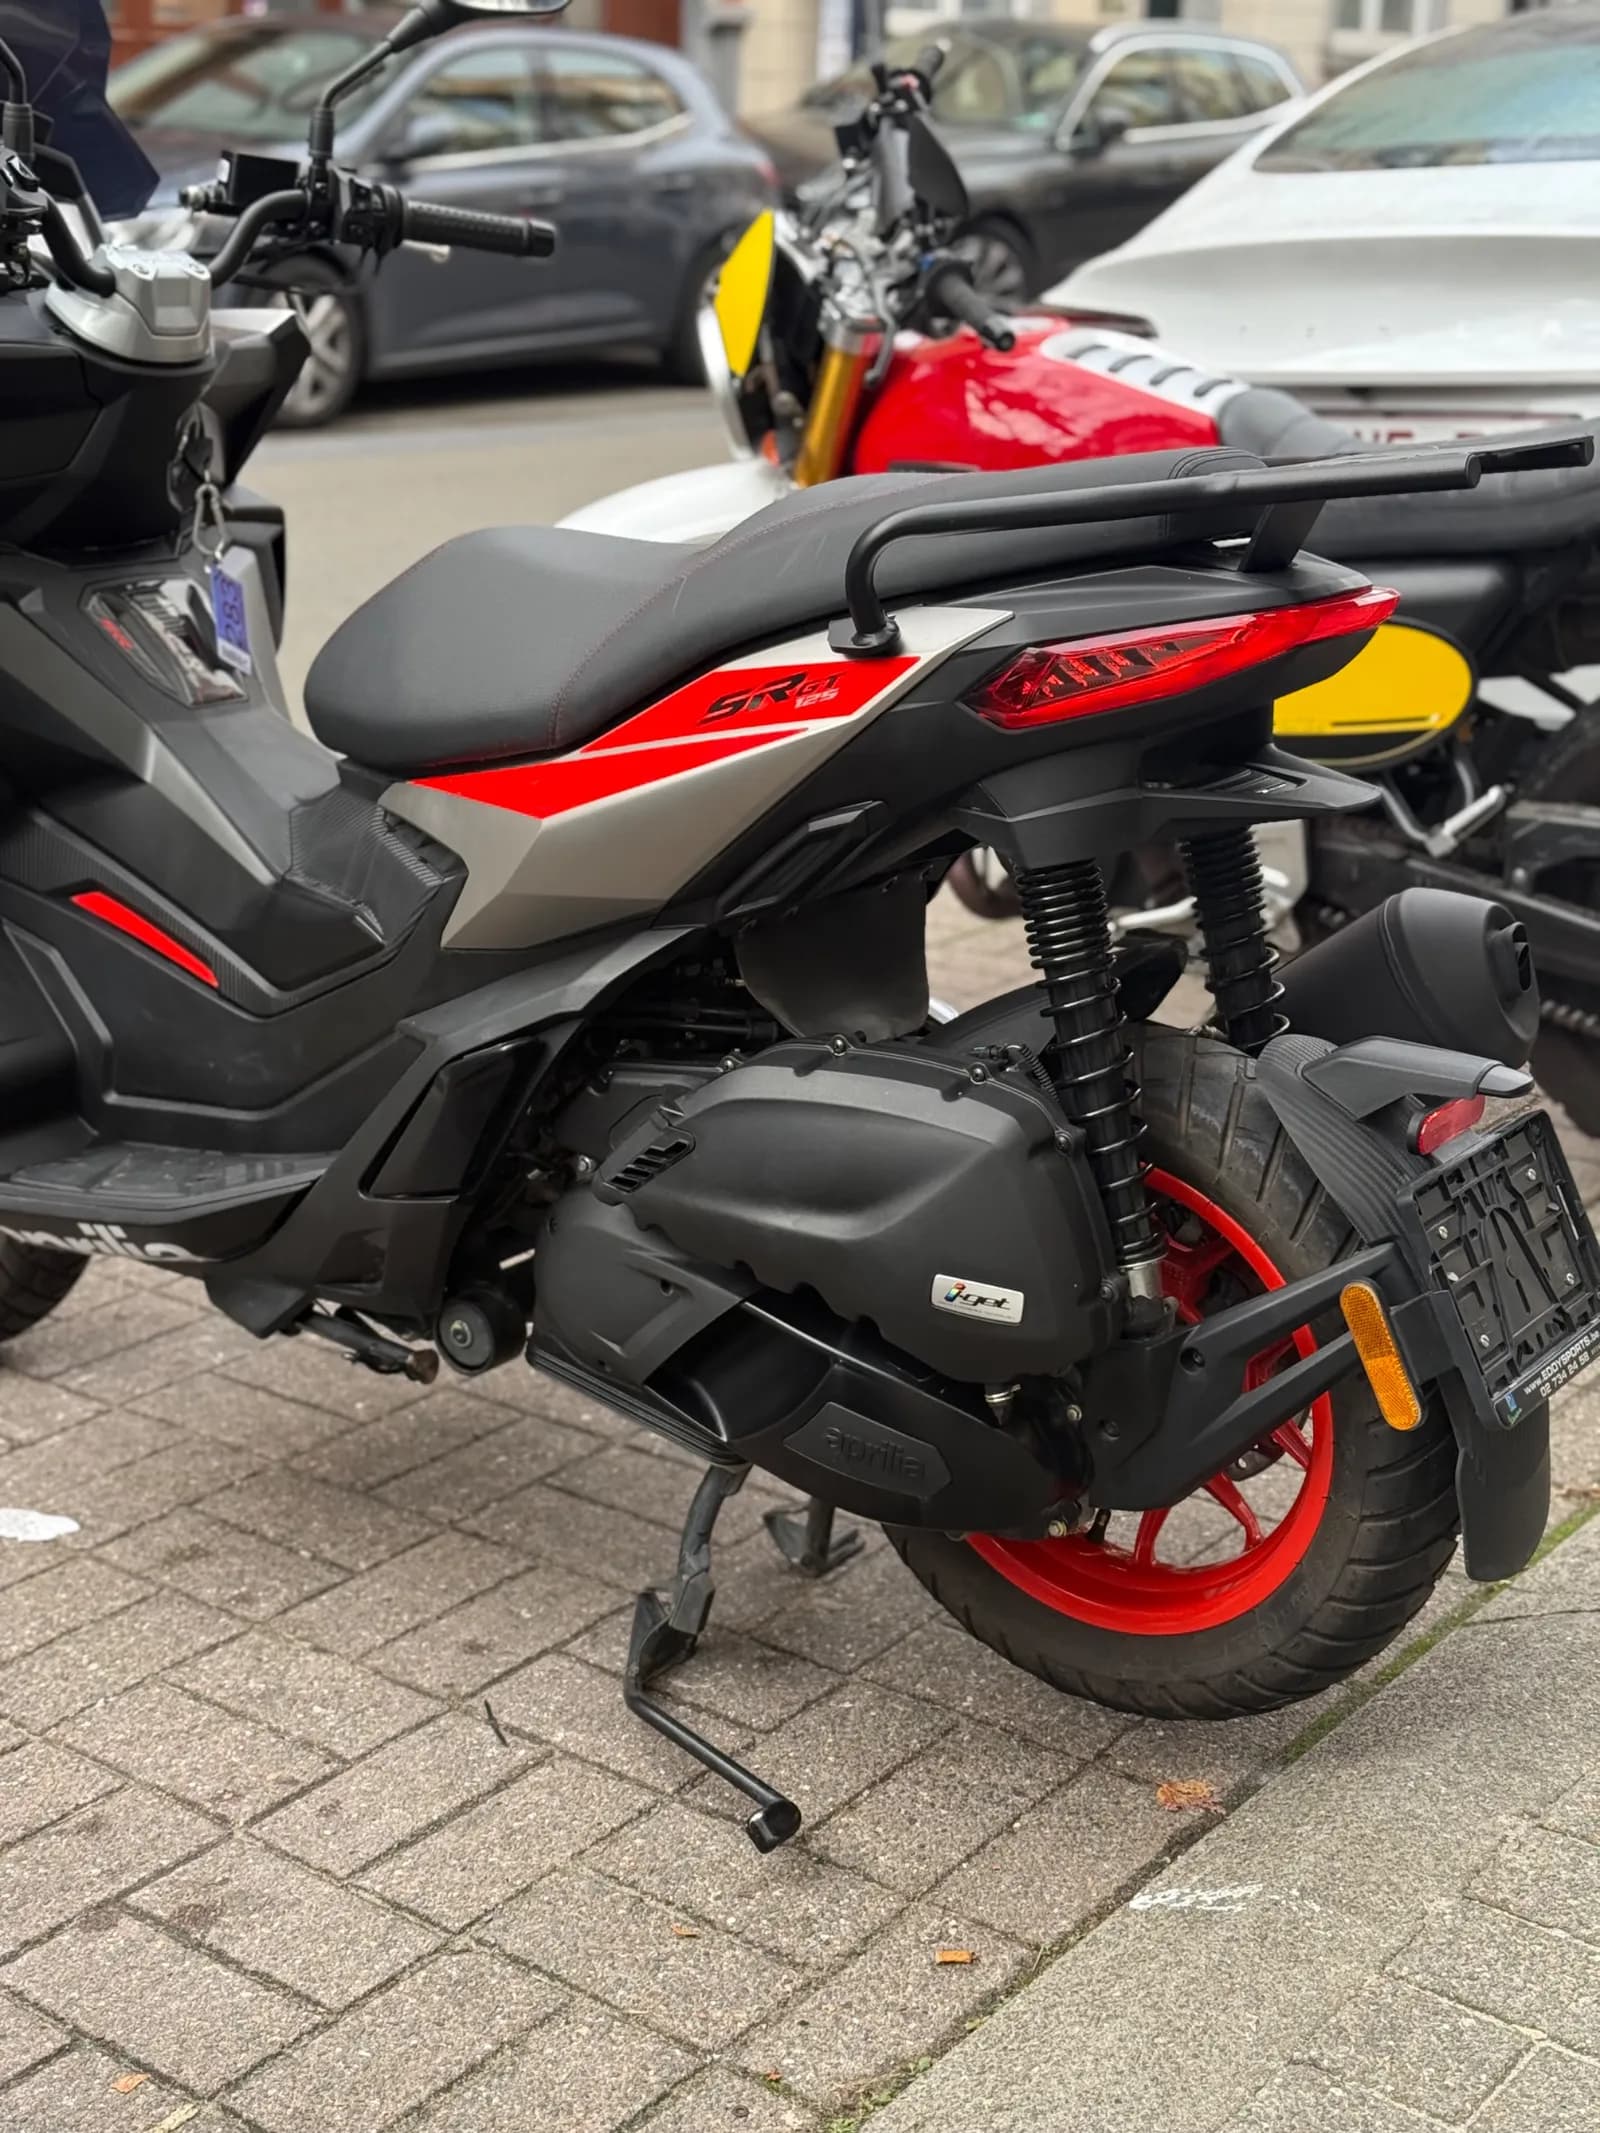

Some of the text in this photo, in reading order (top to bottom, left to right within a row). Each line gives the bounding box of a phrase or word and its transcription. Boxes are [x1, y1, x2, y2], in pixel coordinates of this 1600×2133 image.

[697, 671, 807, 727] SR
[794, 687, 840, 710] 125
[0, 1221, 208, 1263] prilia
[1540, 1351, 1590, 1398] 02 734 24 58
[823, 1426, 926, 1481] aprilia
